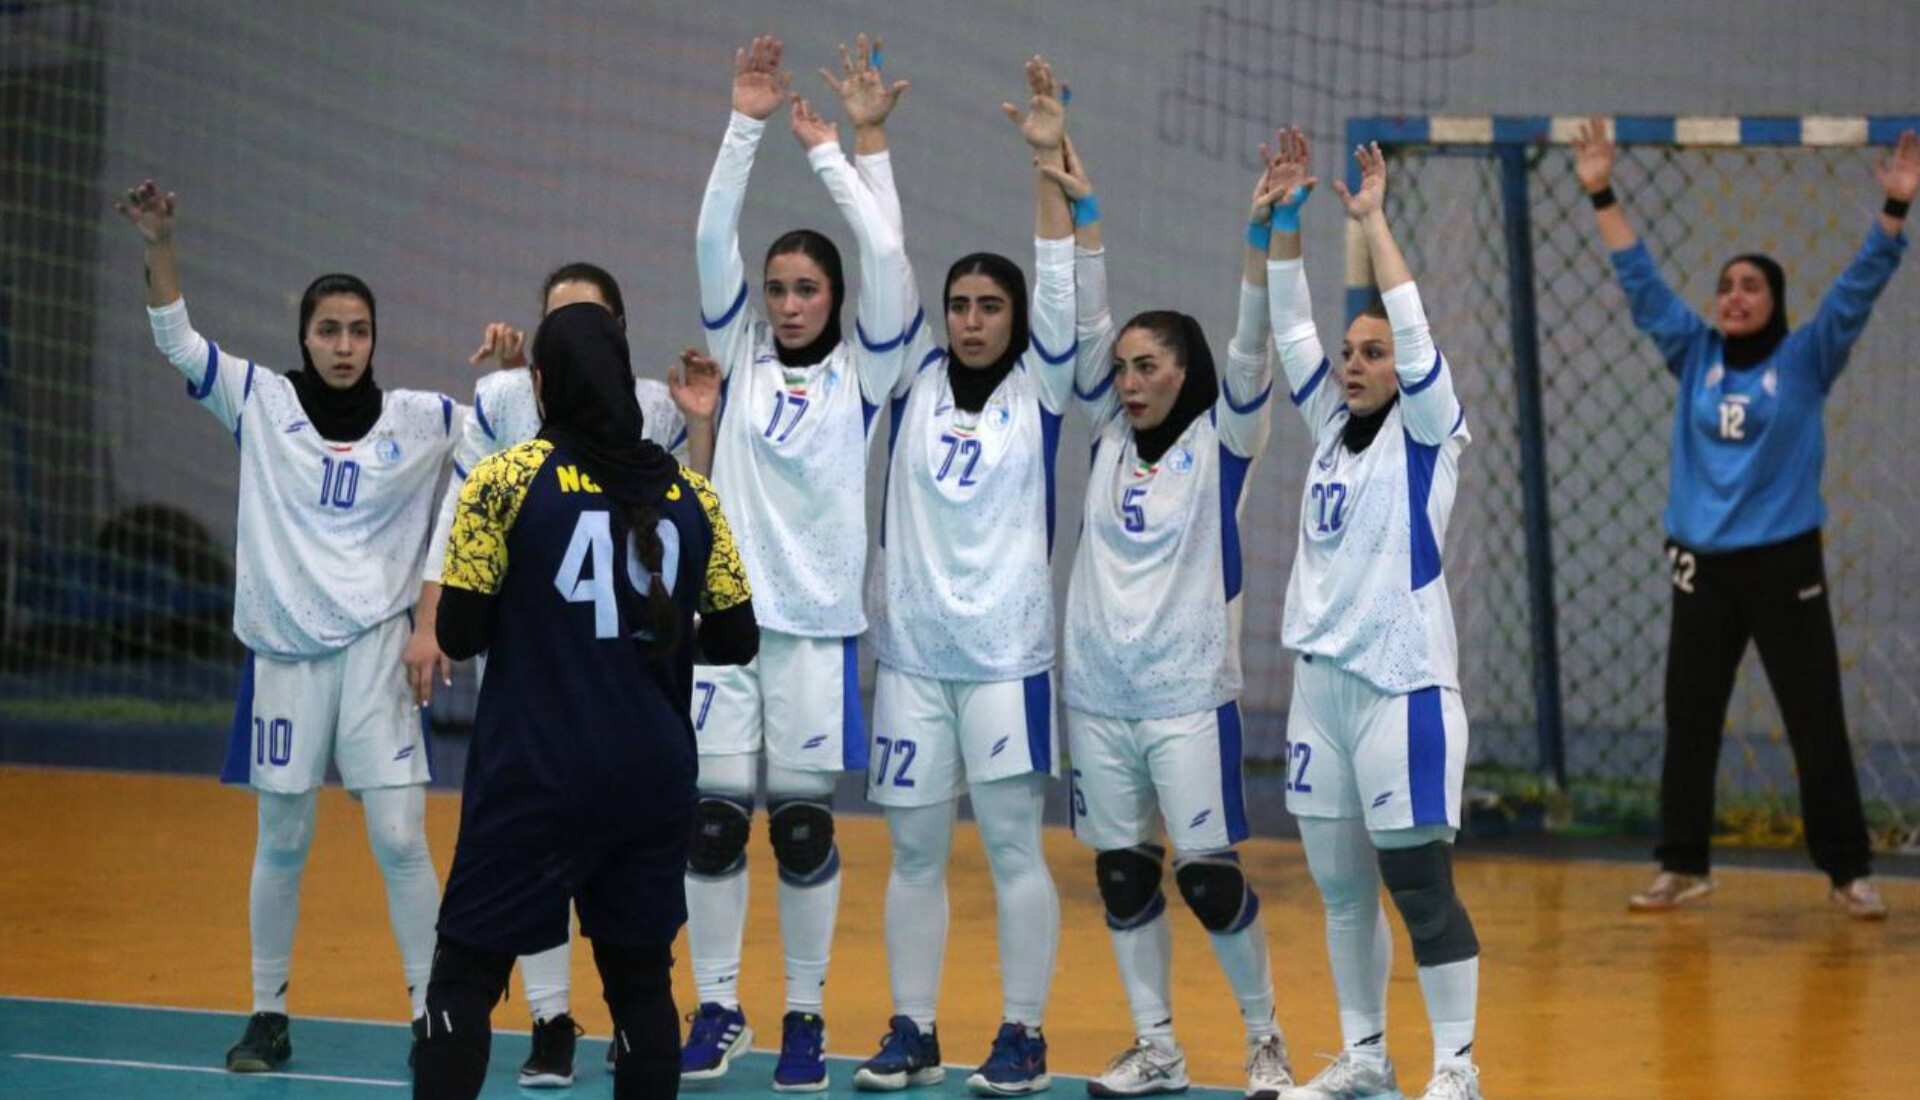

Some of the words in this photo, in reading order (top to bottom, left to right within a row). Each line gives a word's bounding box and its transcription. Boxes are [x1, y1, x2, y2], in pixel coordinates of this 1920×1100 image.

[764, 390, 811, 442] 17
[1718, 402, 1745, 438] 12
[320, 455, 359, 509] 10
[936, 434, 982, 486] 72
[1121, 488, 1146, 533] 5
[695, 681, 716, 731] 7
[254, 716, 293, 767] 10
[875, 735, 917, 788] 72
